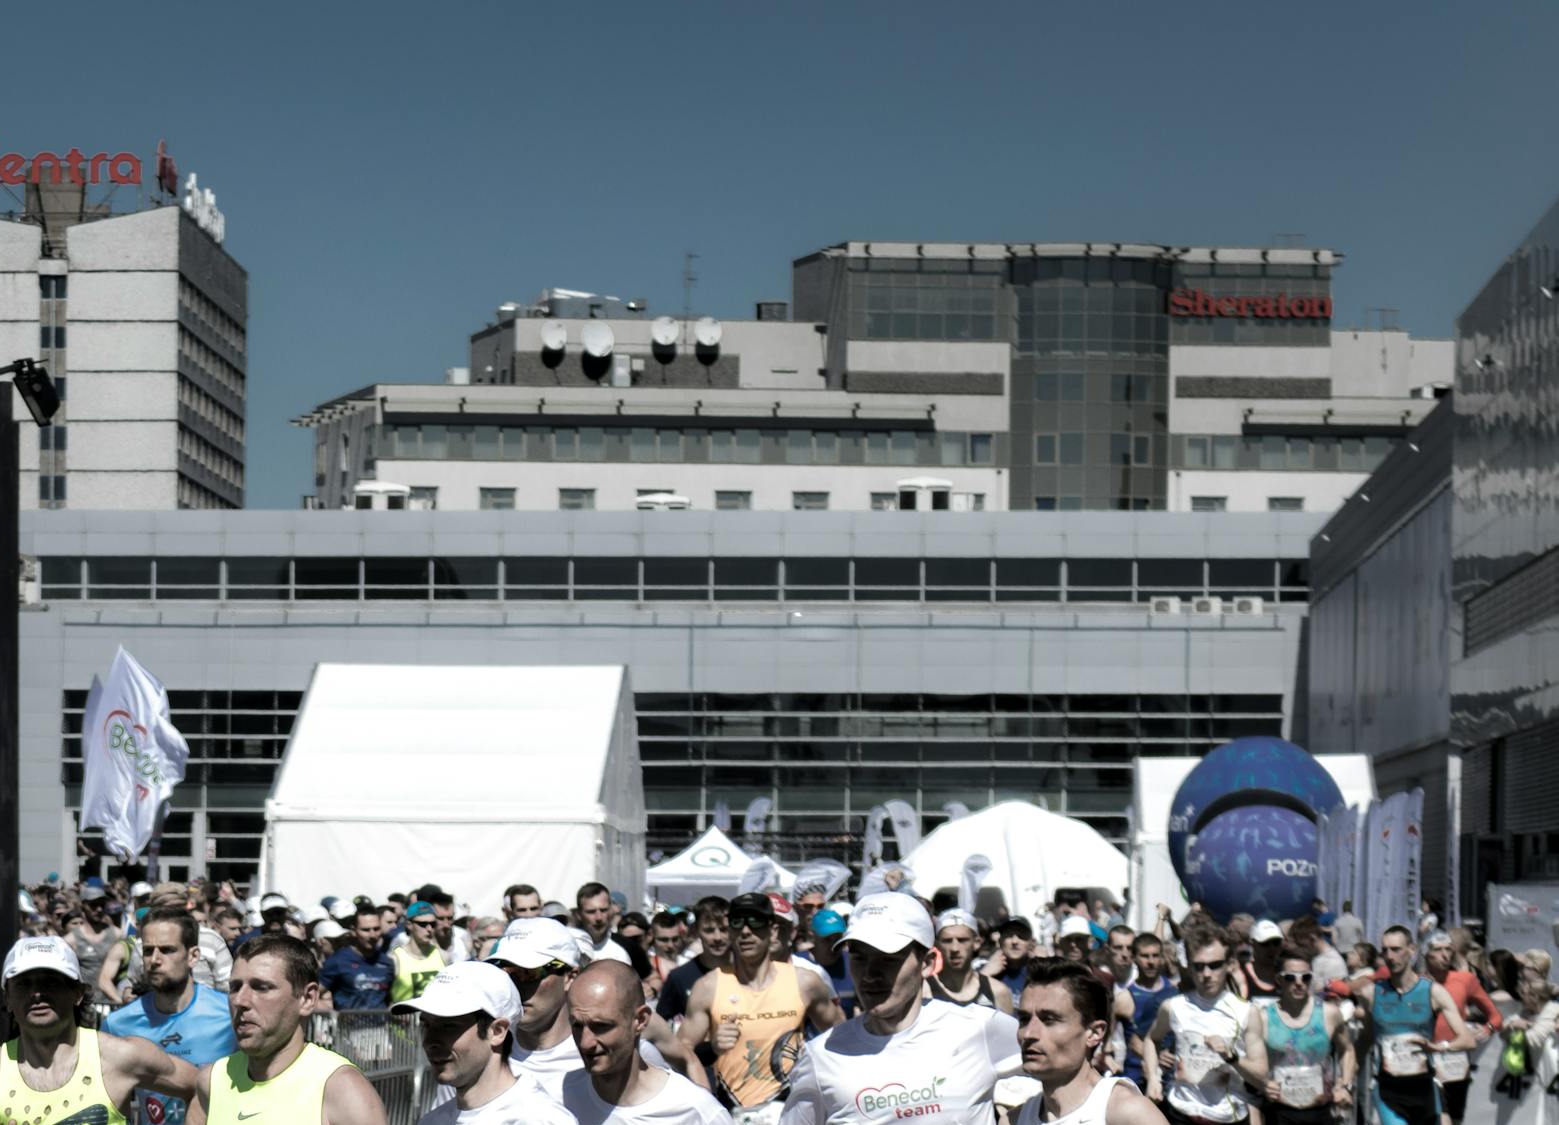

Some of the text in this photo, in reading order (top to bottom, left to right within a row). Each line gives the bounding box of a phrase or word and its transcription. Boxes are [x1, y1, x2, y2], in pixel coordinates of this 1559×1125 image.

[1170, 286, 1333, 319] Sheraton
[863, 1083, 939, 1113] Benecol
[895, 1103, 941, 1119] team
